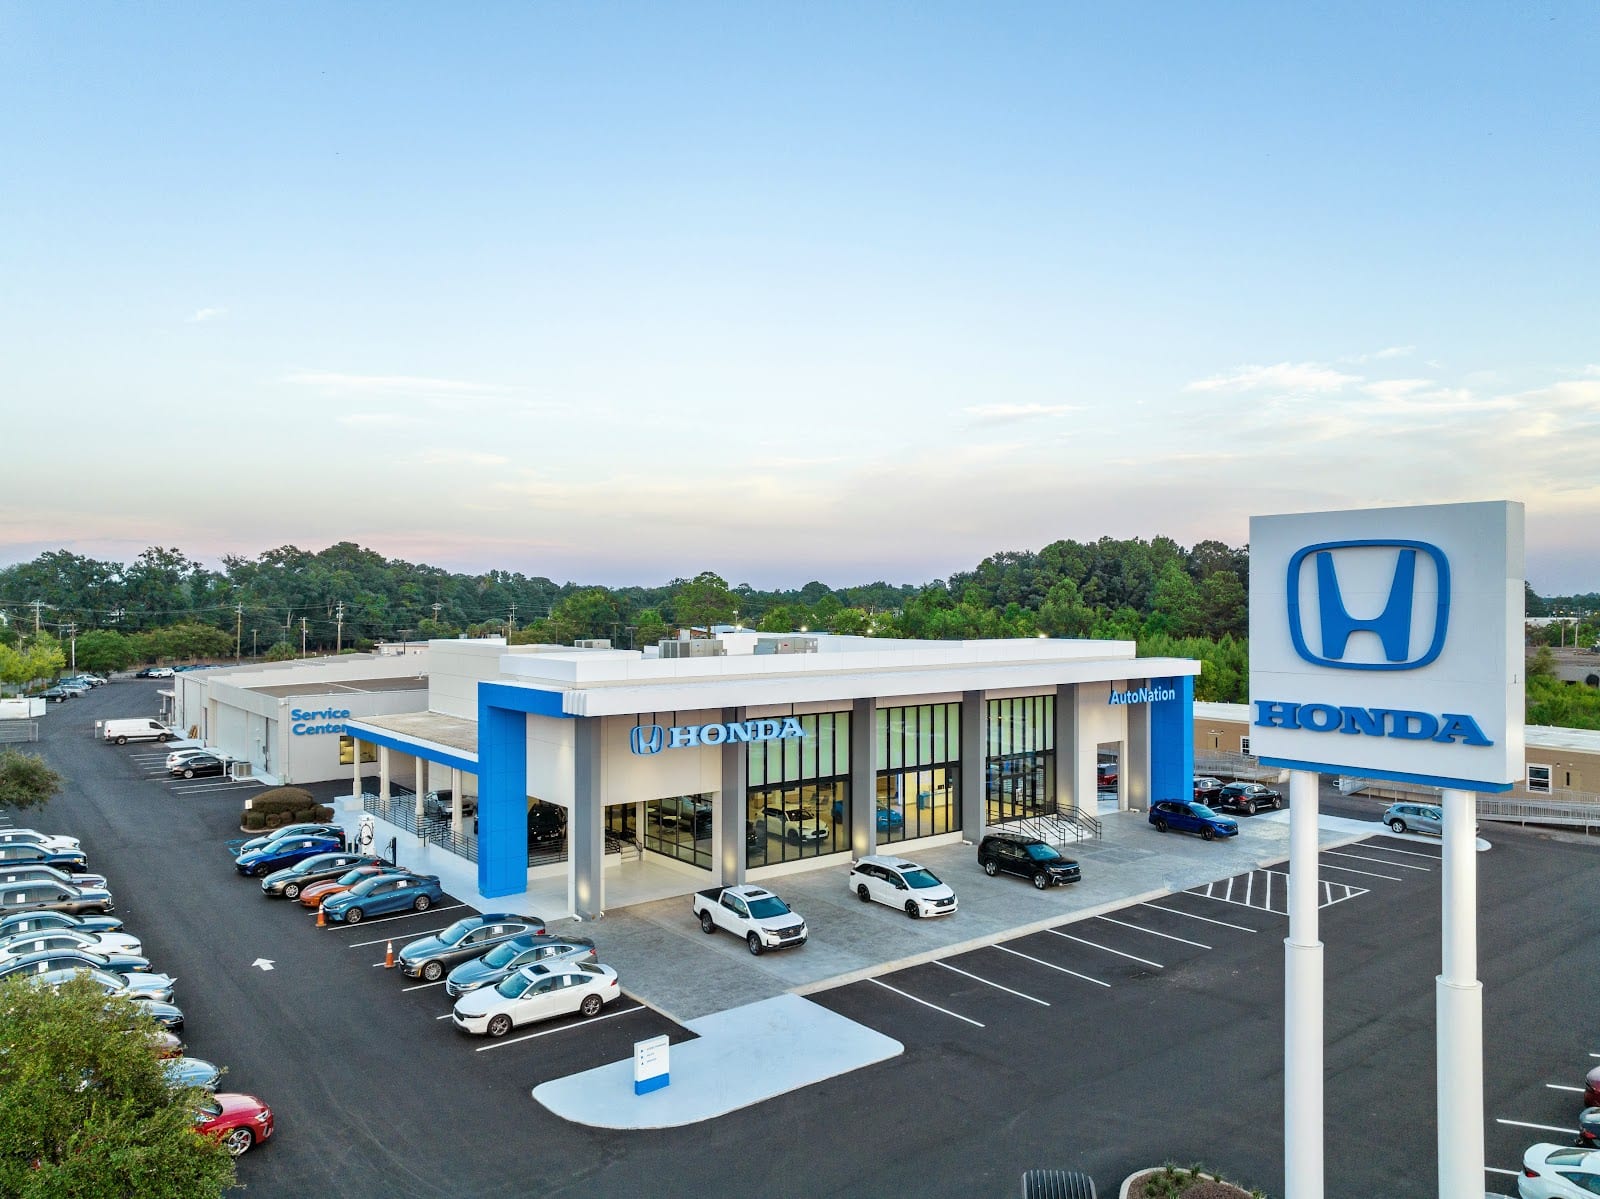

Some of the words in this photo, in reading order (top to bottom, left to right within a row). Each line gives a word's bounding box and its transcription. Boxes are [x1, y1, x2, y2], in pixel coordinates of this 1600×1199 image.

[1109, 686, 1175, 704] AutoNation
[291, 707, 350, 721] Service
[1254, 700, 1494, 746] HONDA
[667, 717, 806, 748] HONDA
